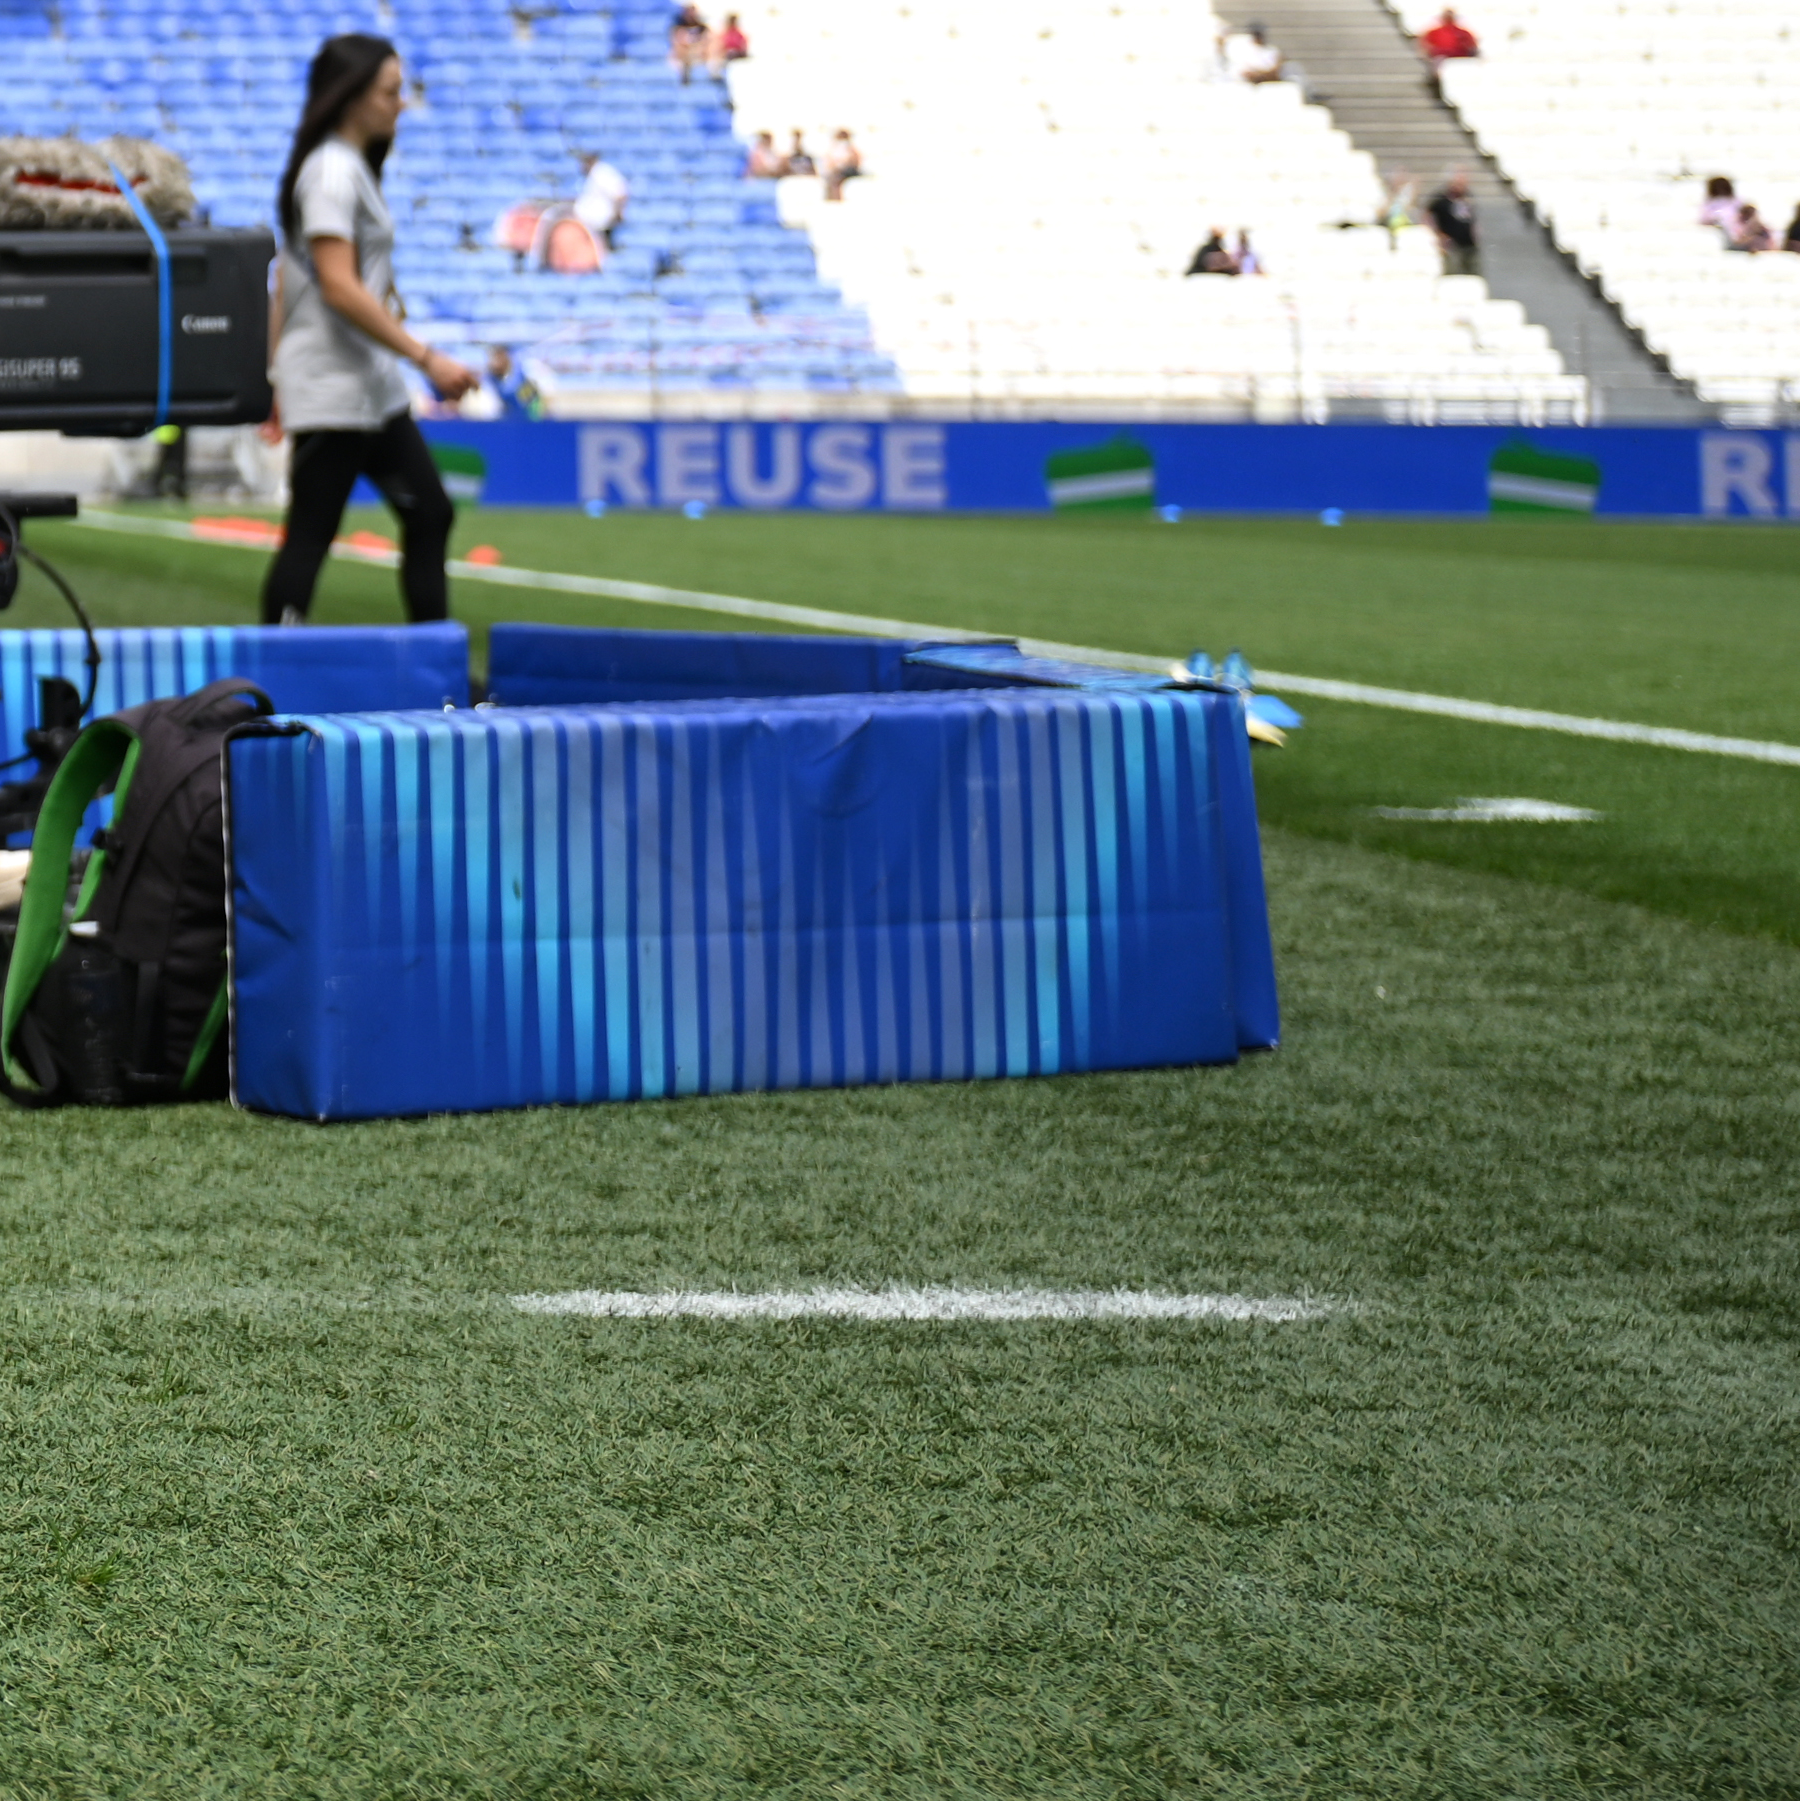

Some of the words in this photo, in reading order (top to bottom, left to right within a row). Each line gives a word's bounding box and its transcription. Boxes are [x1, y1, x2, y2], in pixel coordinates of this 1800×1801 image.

[181, 313, 231, 334] Canon
[59, 356, 82, 380] 95
[576, 425, 947, 510] REUSE
[1700, 431, 1800, 520] R
